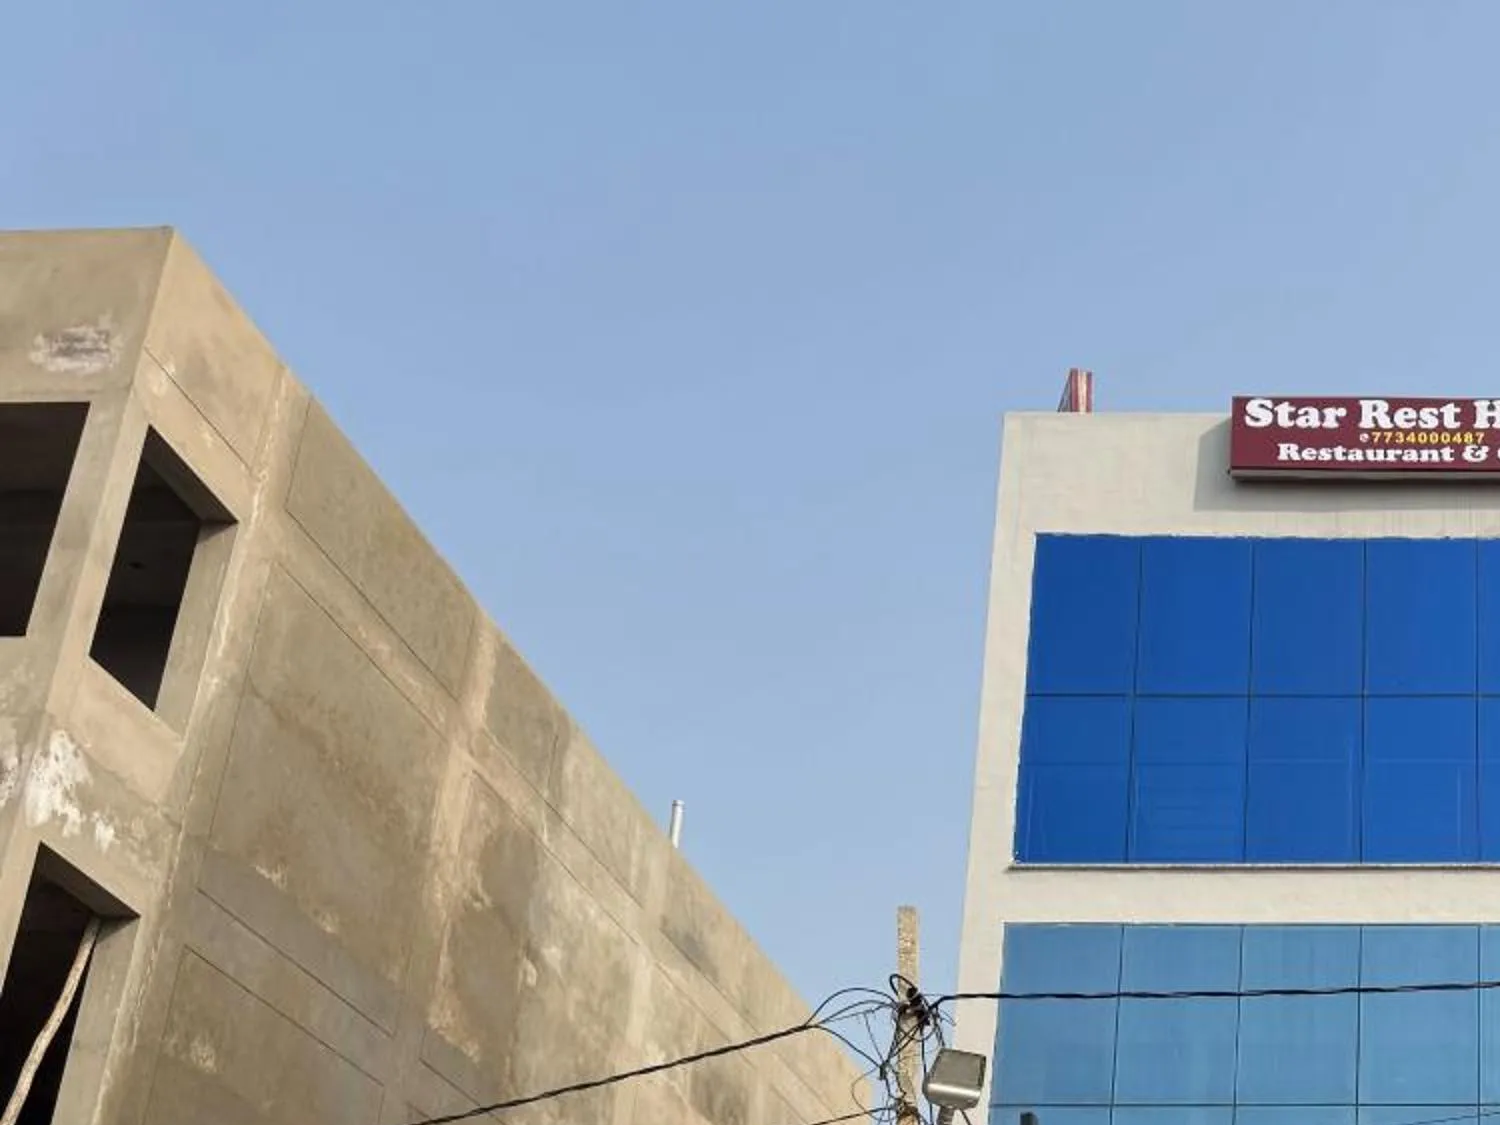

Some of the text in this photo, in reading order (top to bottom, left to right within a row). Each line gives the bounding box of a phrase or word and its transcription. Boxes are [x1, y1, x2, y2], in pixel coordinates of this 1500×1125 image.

[1244, 398, 1347, 429] Star
[1358, 399, 1461, 429] Rest
[1371, 431, 1486, 444] 7734000487
[1277, 443, 1455, 462] Restaurant
[1462, 444, 1489, 462] &
